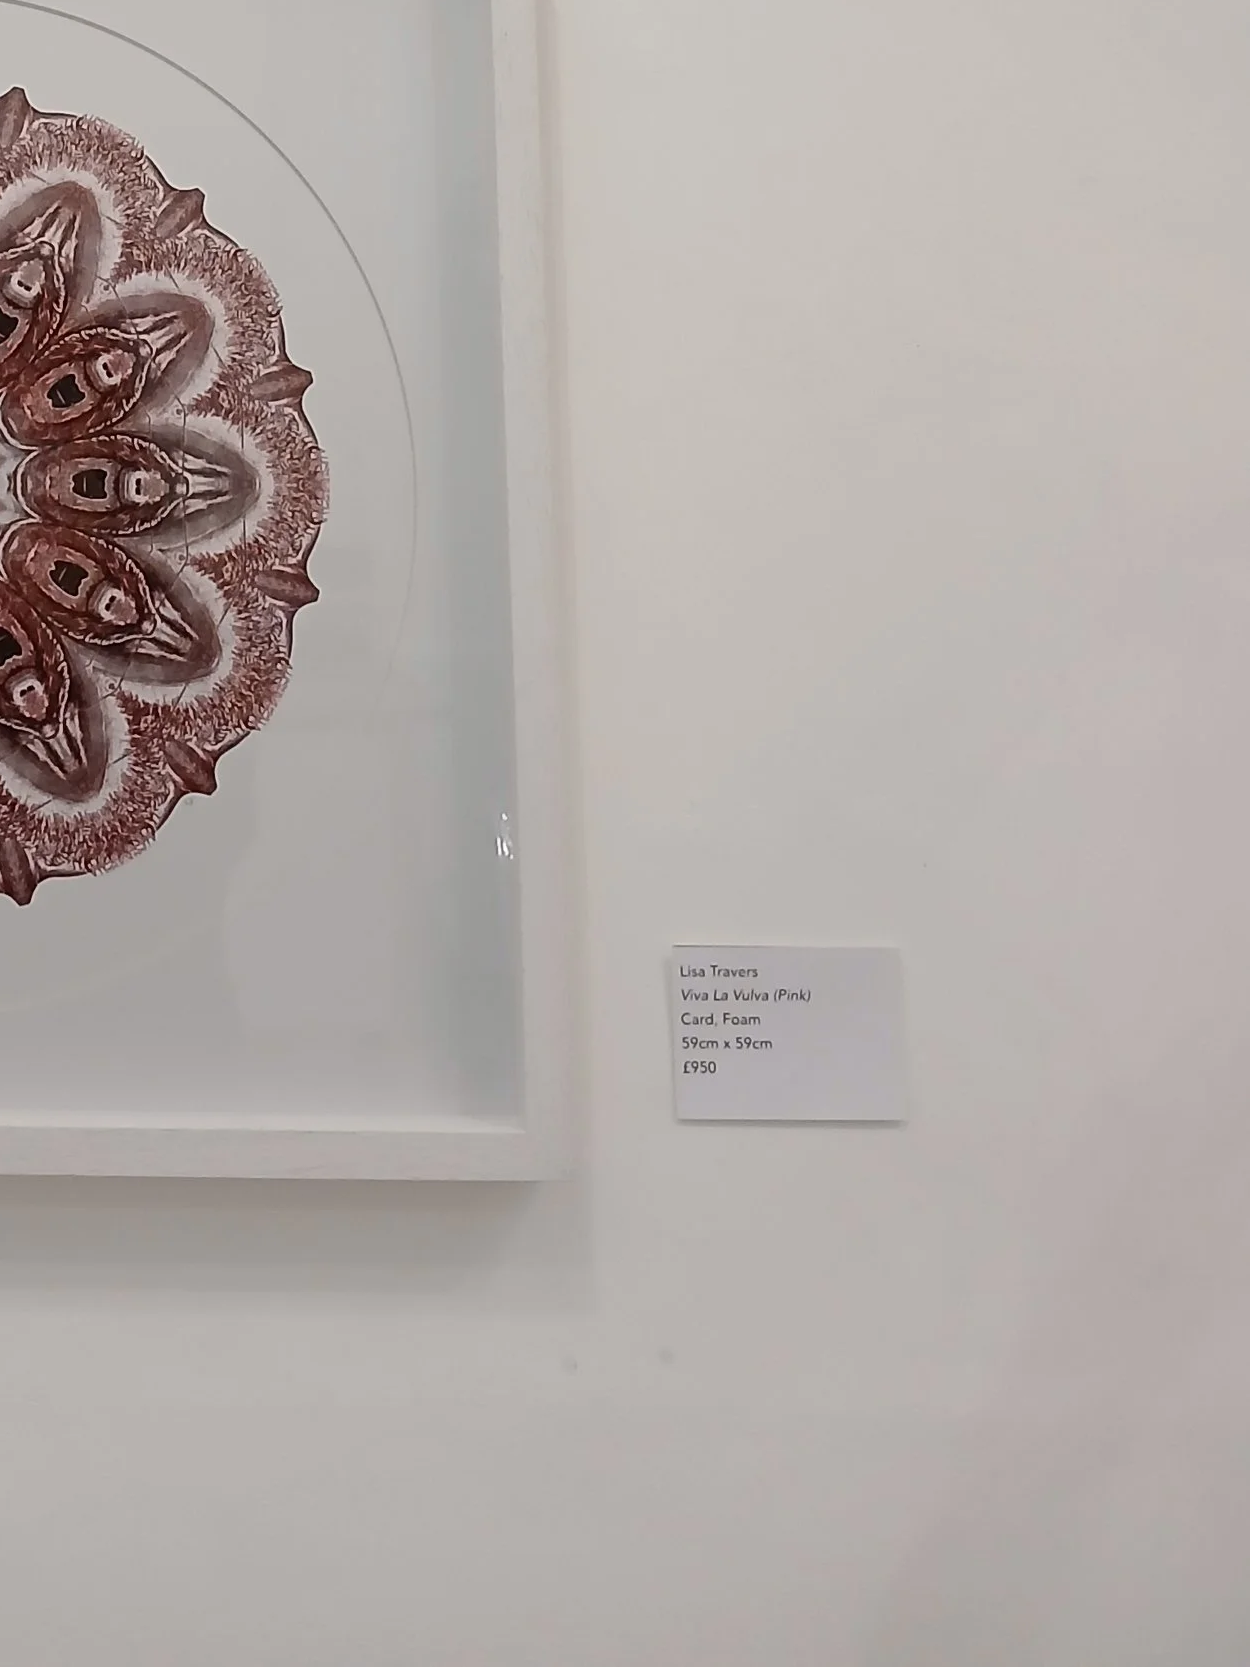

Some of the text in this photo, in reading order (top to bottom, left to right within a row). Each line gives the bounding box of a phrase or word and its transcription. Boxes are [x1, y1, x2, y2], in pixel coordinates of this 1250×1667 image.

[680, 964, 759, 978] Lisa Travers
[681, 988, 811, 1003] Viva La Vulva (Pink)
[680, 1012, 761, 1027] Card, Foam
[682, 1036, 773, 1050] 59cm x 59cm
[683, 1060, 717, 1074] £950
